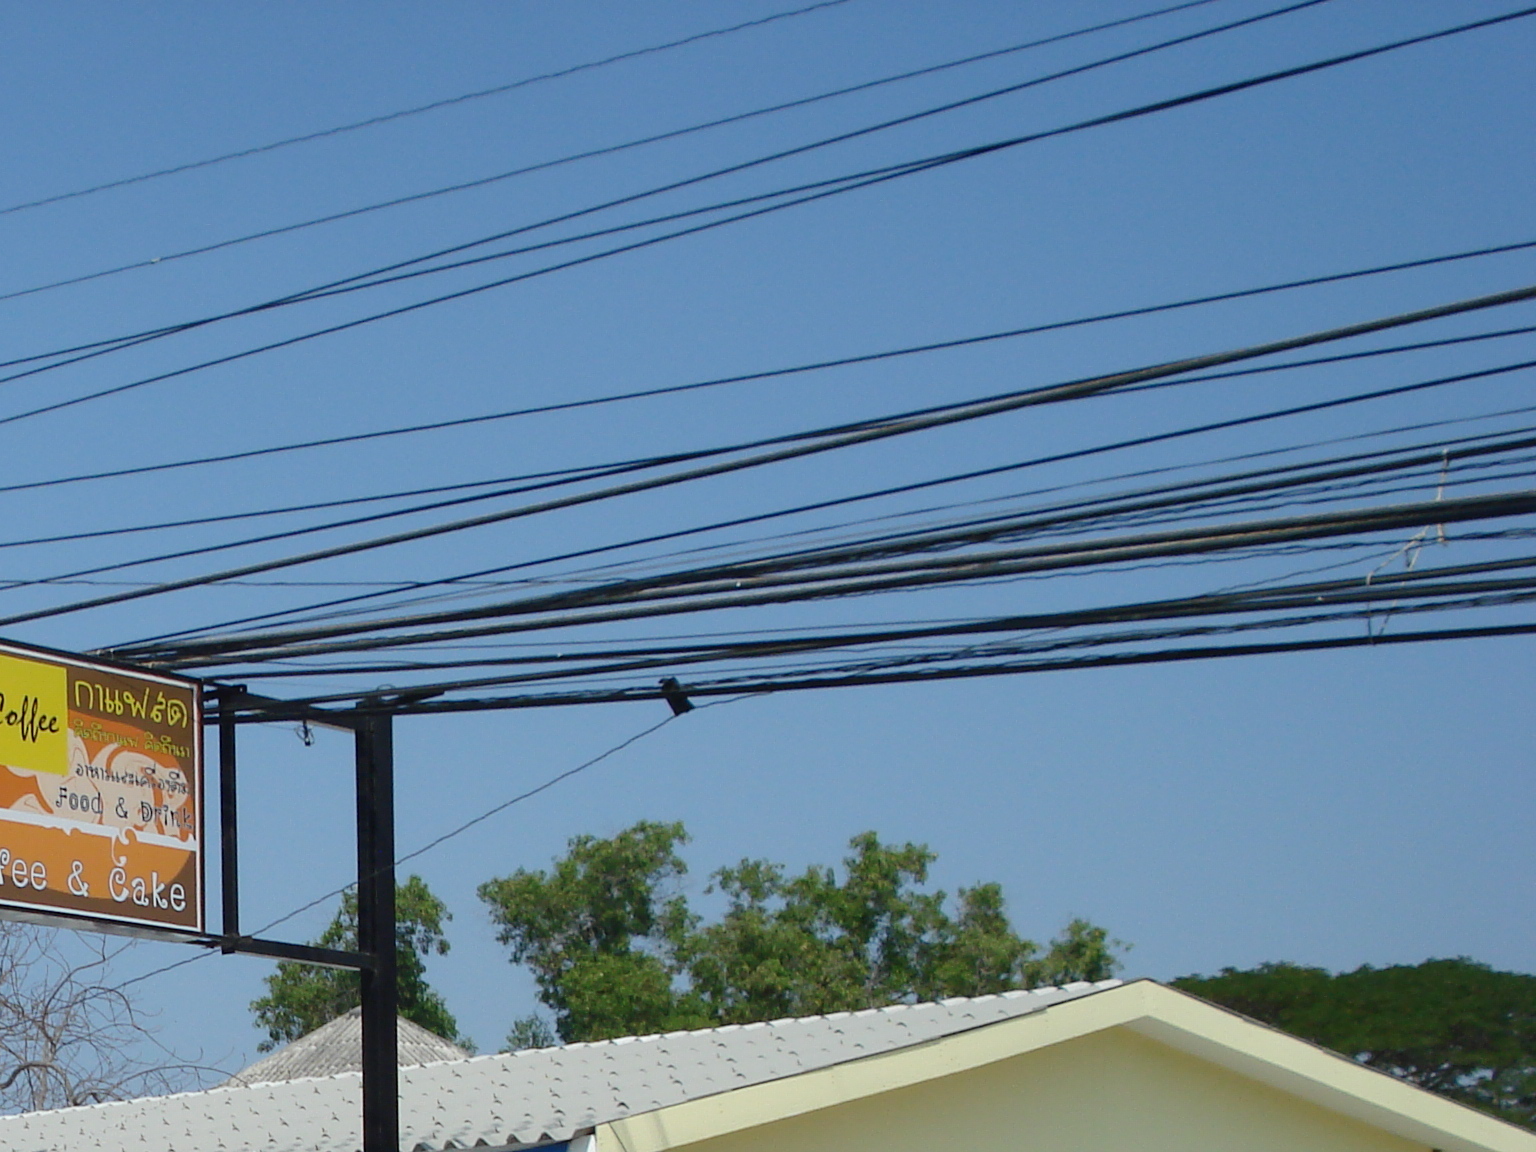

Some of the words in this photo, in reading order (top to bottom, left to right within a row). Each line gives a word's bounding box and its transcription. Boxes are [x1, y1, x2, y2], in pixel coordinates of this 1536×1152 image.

[75, 680, 188, 729] กาแฟสด
[56, 786, 104, 815] Food
[115, 797, 128, 819] &
[140, 800, 193, 830] Drink
[67, 859, 90, 898] &
[108, 861, 187, 911] Cake
